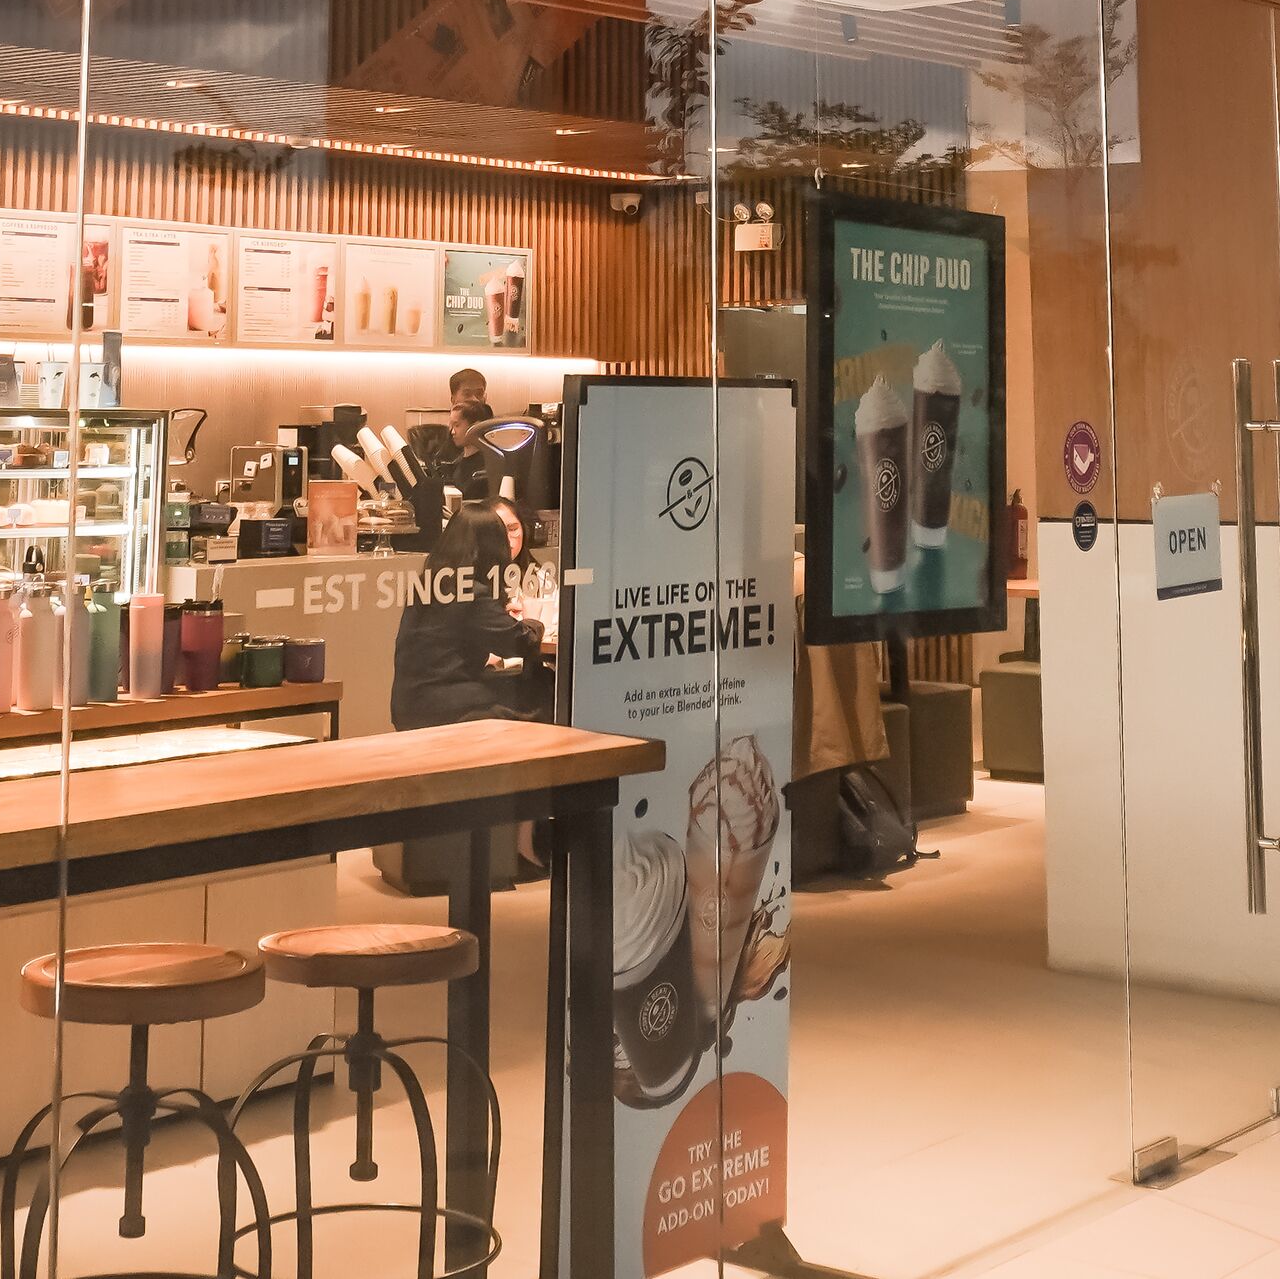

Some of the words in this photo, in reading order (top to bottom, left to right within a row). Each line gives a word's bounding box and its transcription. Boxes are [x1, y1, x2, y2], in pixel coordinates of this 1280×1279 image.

[850, 247, 885, 283] THE
[890, 251, 930, 287] CHIP
[935, 256, 971, 291] DUO
[446, 295, 466, 309] CHIP
[460, 287, 470, 296] THE
[467, 296, 483, 310] DUO
[1169, 526, 1207, 555] OPEN
[303, 573, 366, 615] EST
[376, 566, 475, 609] SINCE
[615, 586, 651, 609] LIVE
[656, 583, 689, 606] LIFE
[695, 581, 718, 602] ON
[725, 578, 757, 599] THE
[592, 603, 775, 665] EXTREME!
[624, 688, 643, 703] Add
[646, 690, 656, 700] an
[658, 685, 681, 699] extra
[683, 682, 700, 695] kick
[702, 679, 711, 693] of
[713, 677, 746, 692] ffeine
[628, 708, 637, 719] to
[640, 705, 660, 721] your
[663, 702, 675, 714] Ice
[719, 692, 742, 706] drink.
[688, 1140, 713, 1164] TRY
[716, 1130, 742, 1152] HE
[658, 1175, 686, 1204] GO
[692, 1146, 770, 1193] EXREME
[657, 1198, 714, 1236] ADD-ON
